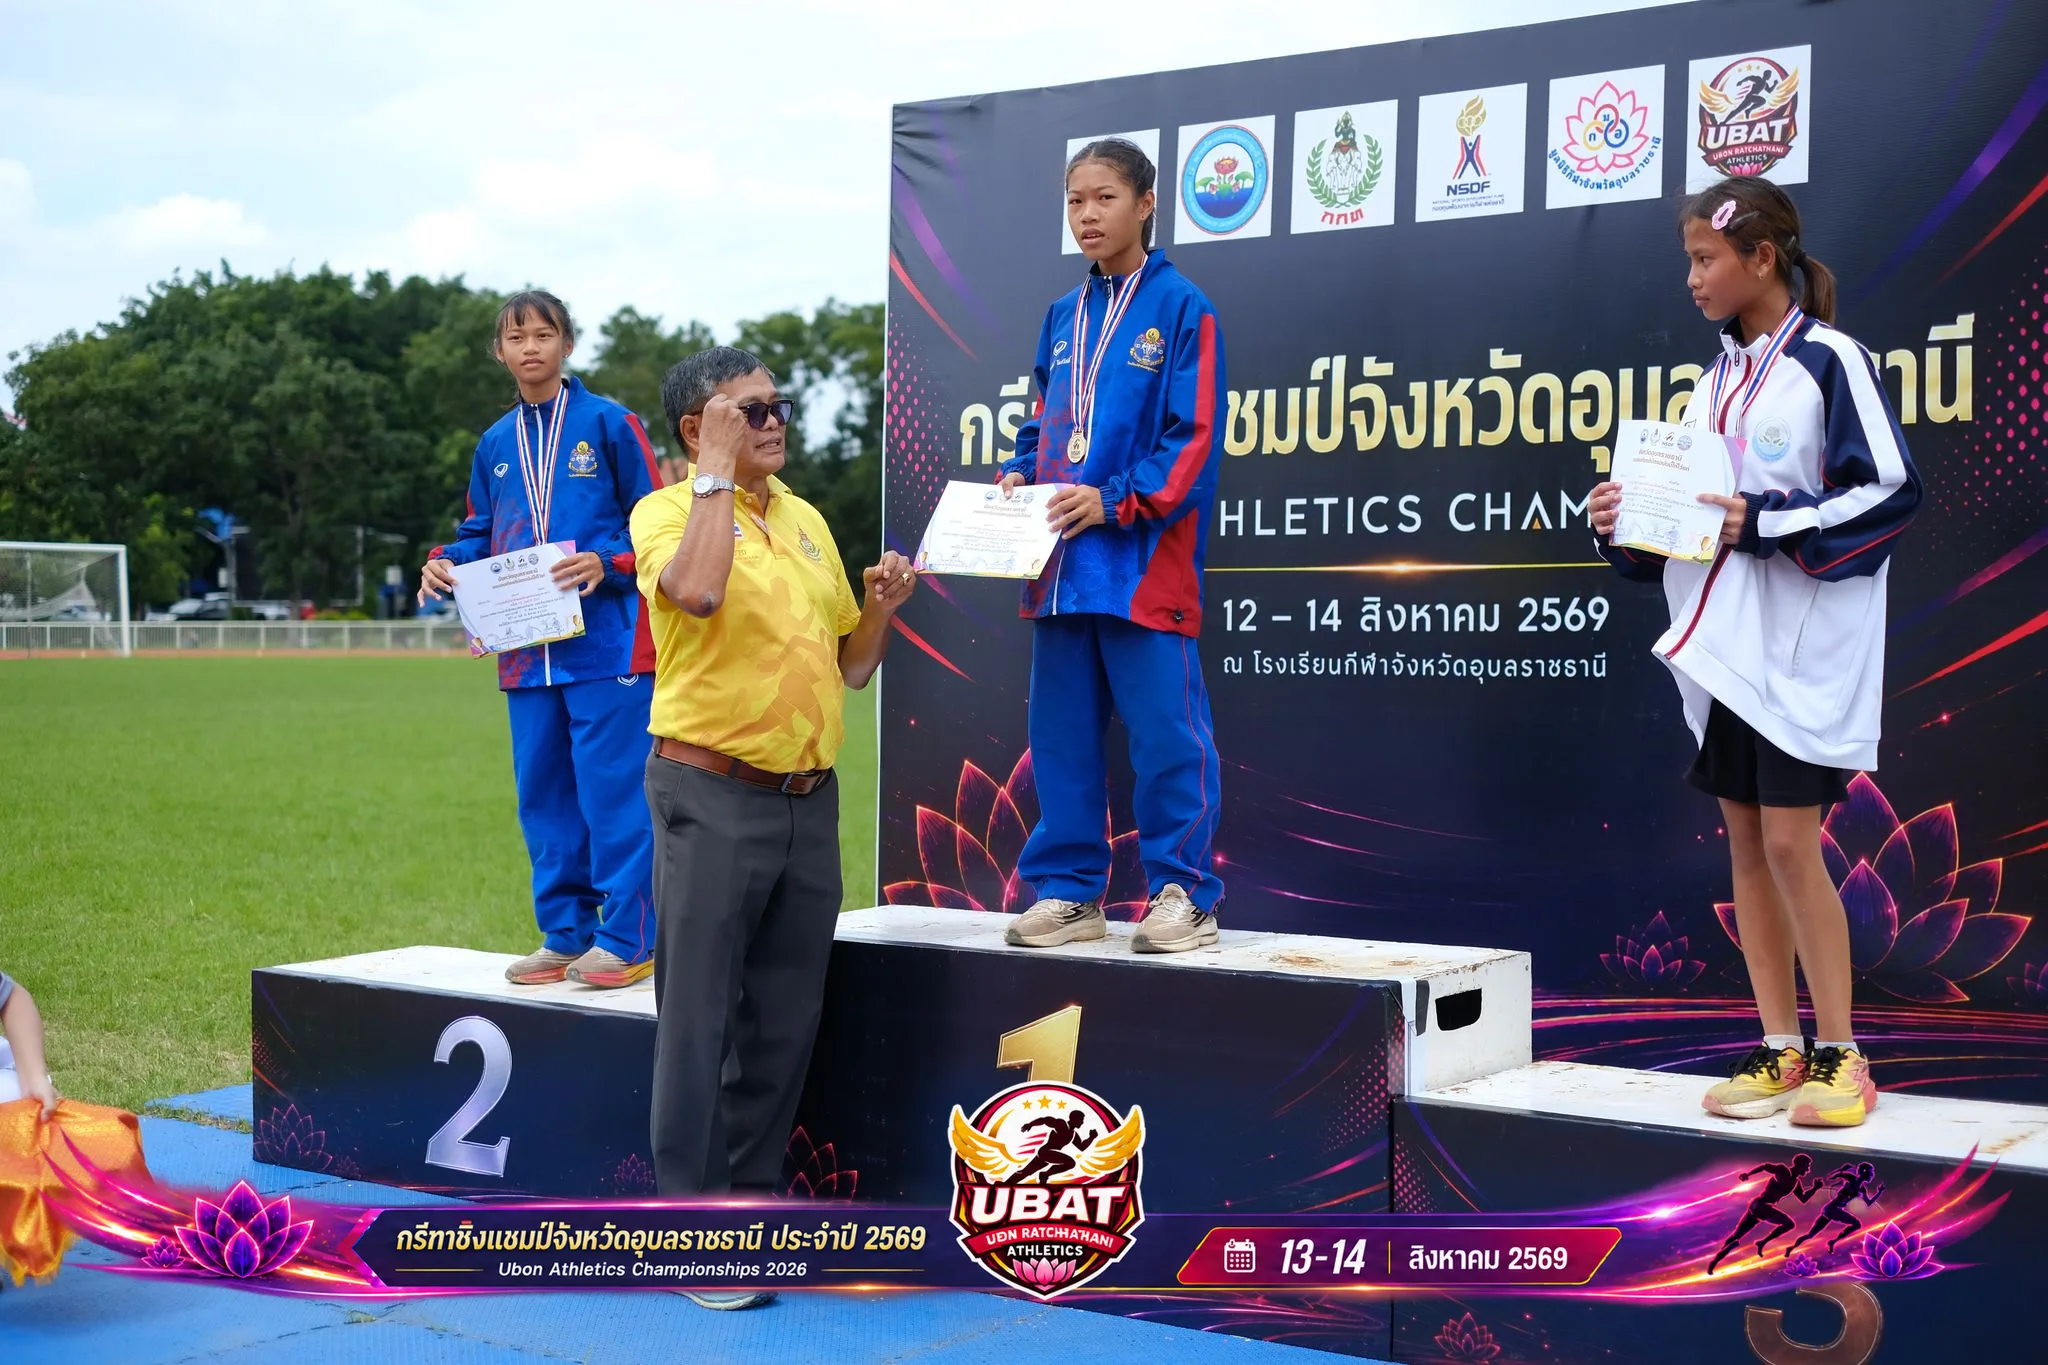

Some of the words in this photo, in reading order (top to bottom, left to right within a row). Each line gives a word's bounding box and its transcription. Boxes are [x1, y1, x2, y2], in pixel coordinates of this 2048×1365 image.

[1588, 132, 1596, 142] ก
[1705, 118, 1790, 149] UBAT
[1712, 149, 1733, 161] UBON
[1726, 153, 1768, 165] ATHLETICS
[1446, 181, 1491, 197] NSDF
[1321, 207, 1364, 225] กกท
[1219, 494, 1422, 537] HLETICS
[1448, 489, 1592, 532] CHAM
[1223, 598, 1258, 632] 12
[1306, 598, 1342, 632] 14
[1360, 596, 1500, 632] สิงหาคม
[1518, 596, 1609, 632] 2569
[1223, 656, 1243, 674] ณ
[1253, 650, 1607, 685] โรงเรียนกีฬาจังหวัดอุบลราชธานี
[424, 1015, 514, 1178] 2
